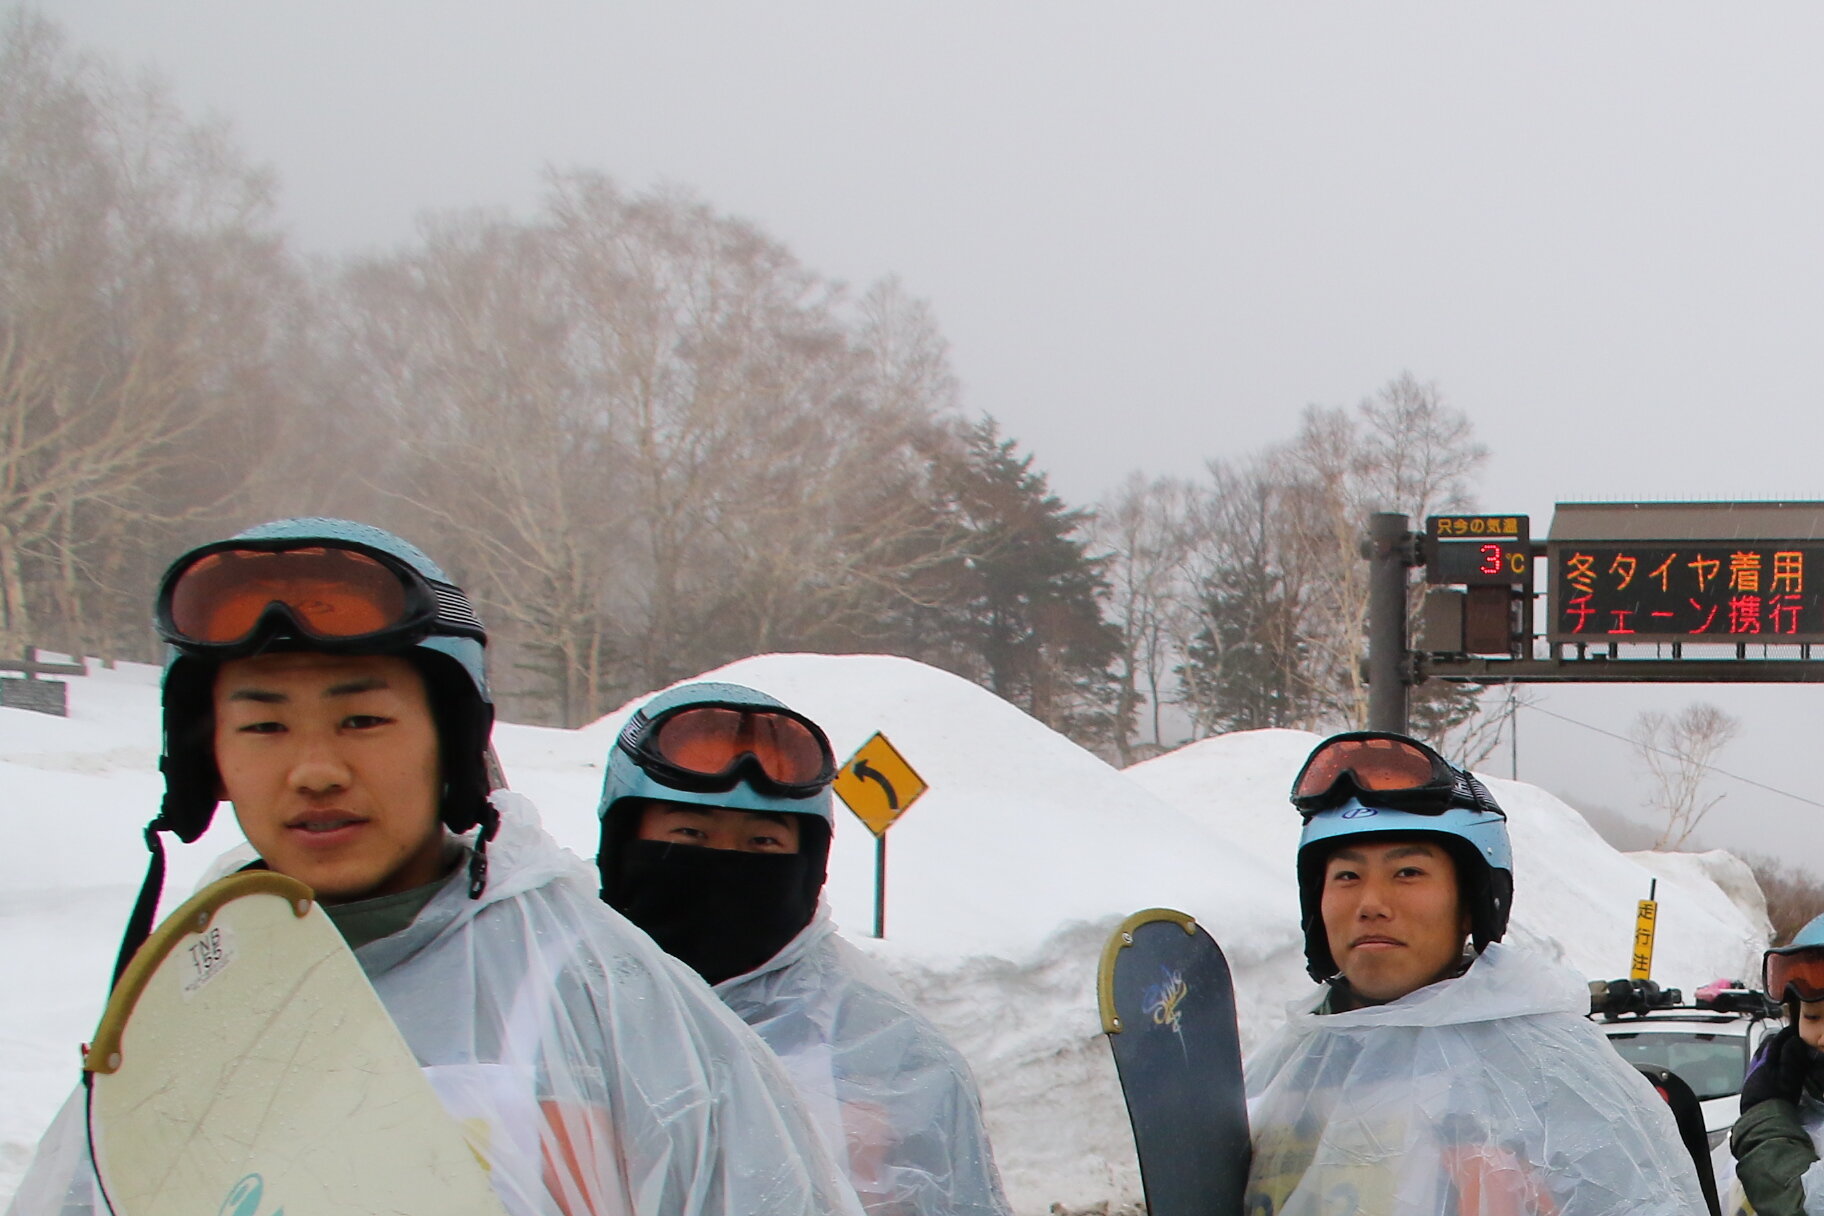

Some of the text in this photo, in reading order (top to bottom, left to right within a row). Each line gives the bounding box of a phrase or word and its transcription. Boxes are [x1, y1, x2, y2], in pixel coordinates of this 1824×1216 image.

[1437, 518, 1518, 535] 只今の気温
[188, 927, 220, 963] TNB
